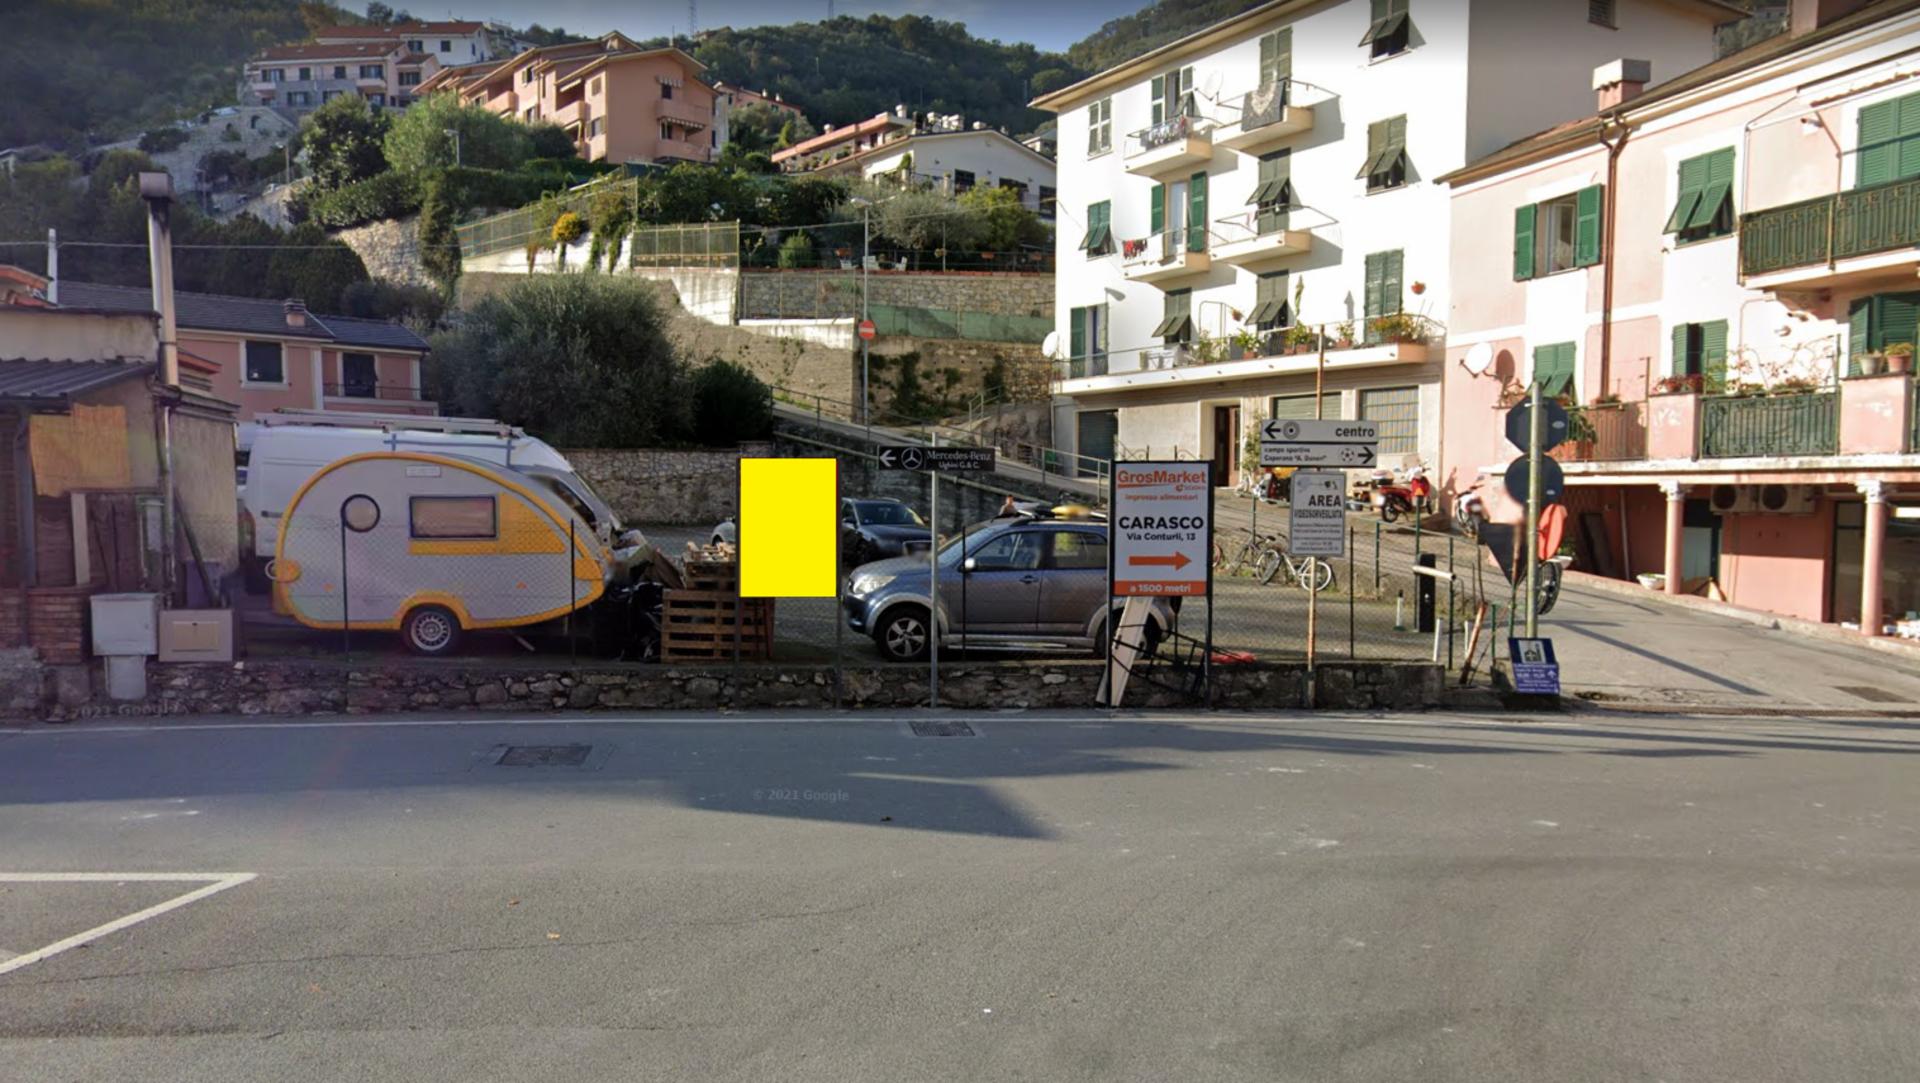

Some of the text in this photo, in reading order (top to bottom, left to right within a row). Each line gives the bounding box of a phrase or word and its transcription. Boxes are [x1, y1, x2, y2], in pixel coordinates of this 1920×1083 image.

[1335, 426, 1375, 437] centro
[927, 450, 992, 460] Mercedes-Benz
[1117, 470, 1206, 483] GrosMarket
[1308, 495, 1341, 506] AREA
[1118, 516, 1204, 529] CARASCO
[1138, 584, 1162, 592] 1500
[1164, 584, 1191, 592] metri
